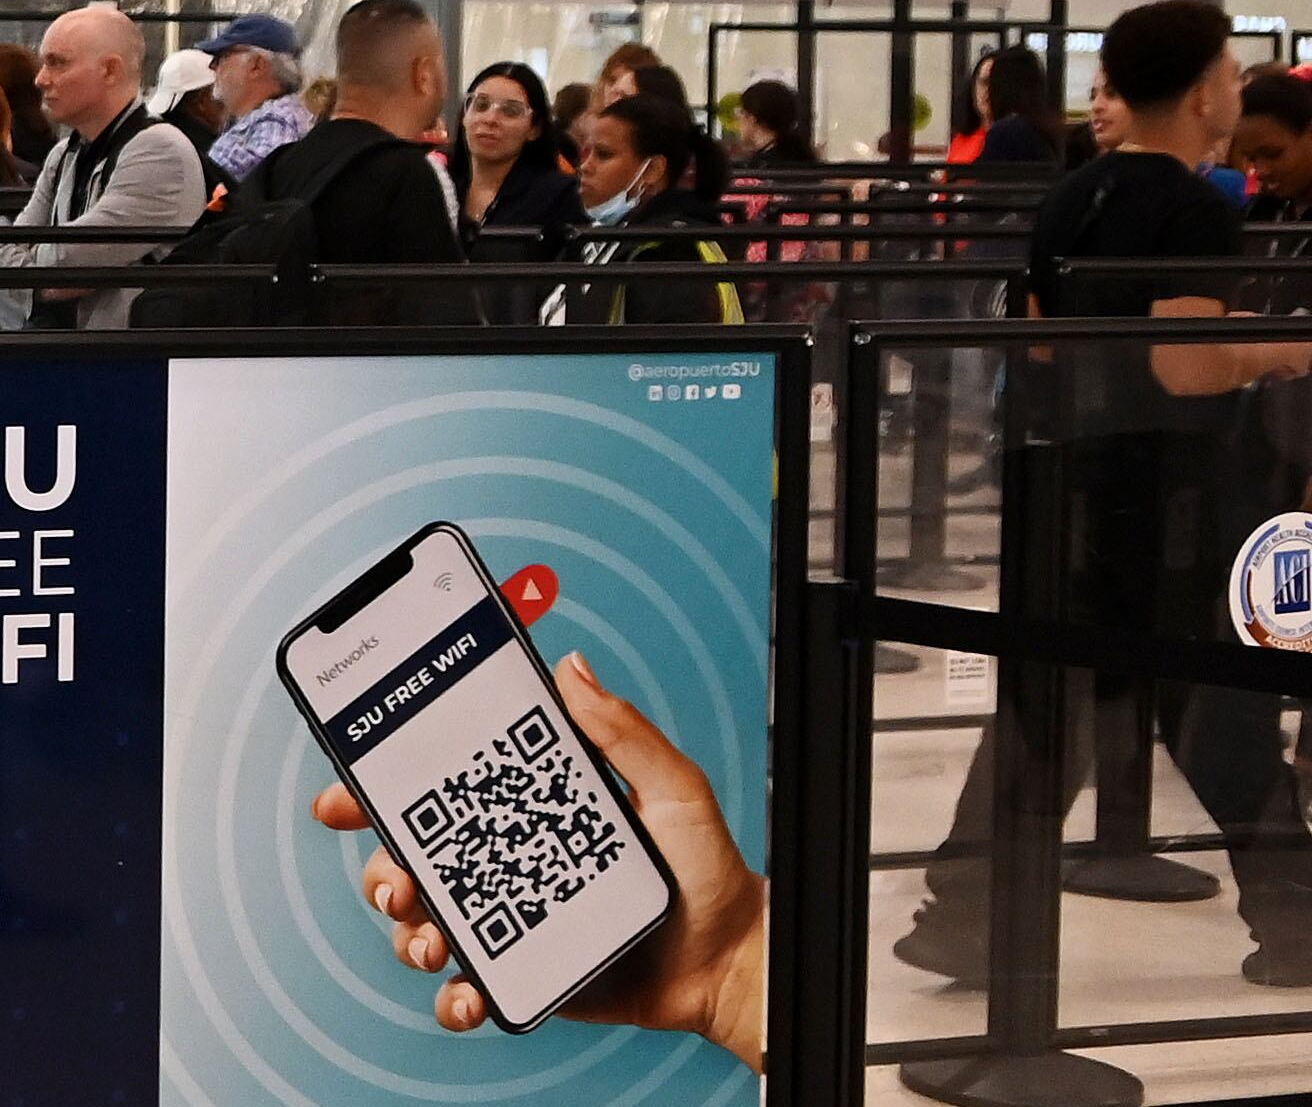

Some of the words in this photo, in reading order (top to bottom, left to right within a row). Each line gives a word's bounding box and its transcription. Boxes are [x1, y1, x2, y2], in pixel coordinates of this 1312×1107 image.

[628, 361, 761, 383] @aeropuertoSJU
[1276, 554, 1308, 605] ACI
[316, 635, 380, 687] Networks
[347, 705, 385, 742] SJU
[384, 667, 435, 713] FREE
[432, 632, 478, 673] WIFI
